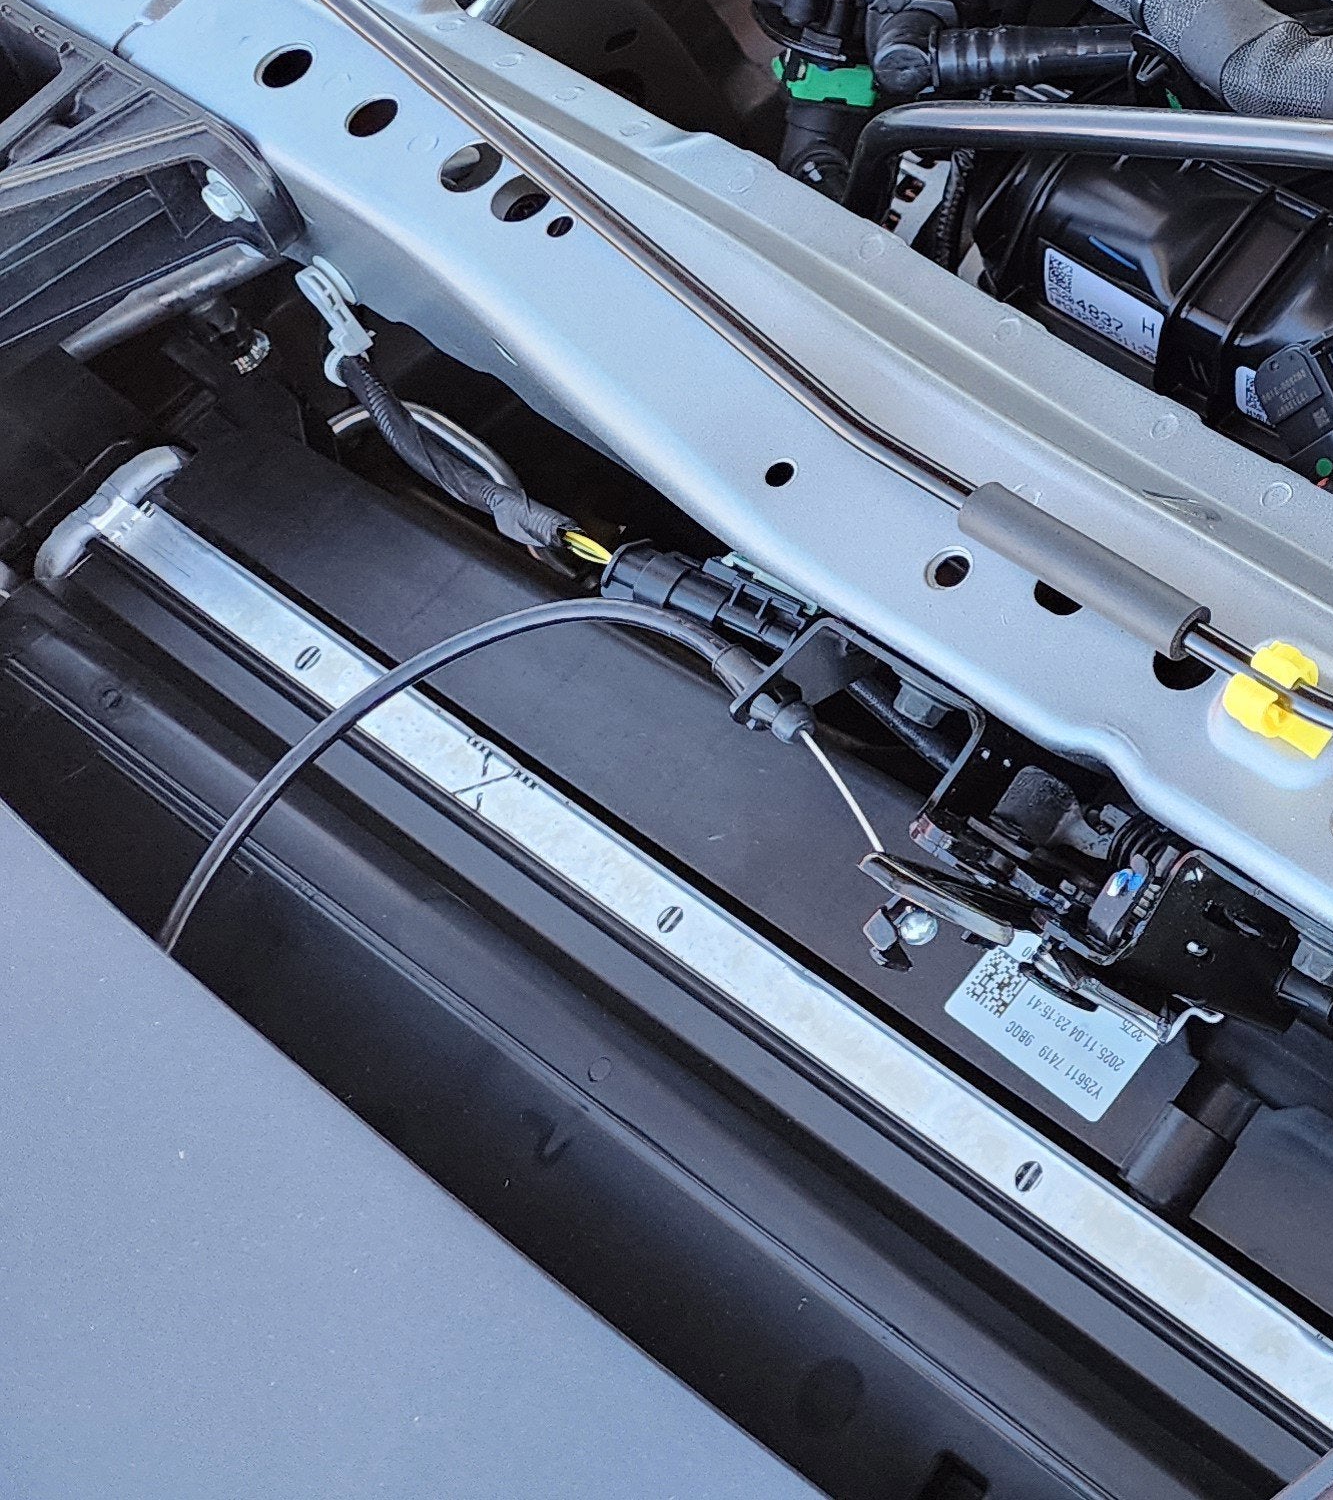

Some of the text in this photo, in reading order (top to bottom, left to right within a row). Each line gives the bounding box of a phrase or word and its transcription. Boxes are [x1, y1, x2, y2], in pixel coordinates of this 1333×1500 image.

[1142, 317, 1155, 339] H
[1026, 994, 1126, 1072] 2025.11.04 23:15:41
[1037, 1045, 1065, 1071] 7419
[1064, 1065, 1103, 1100] Y25611
